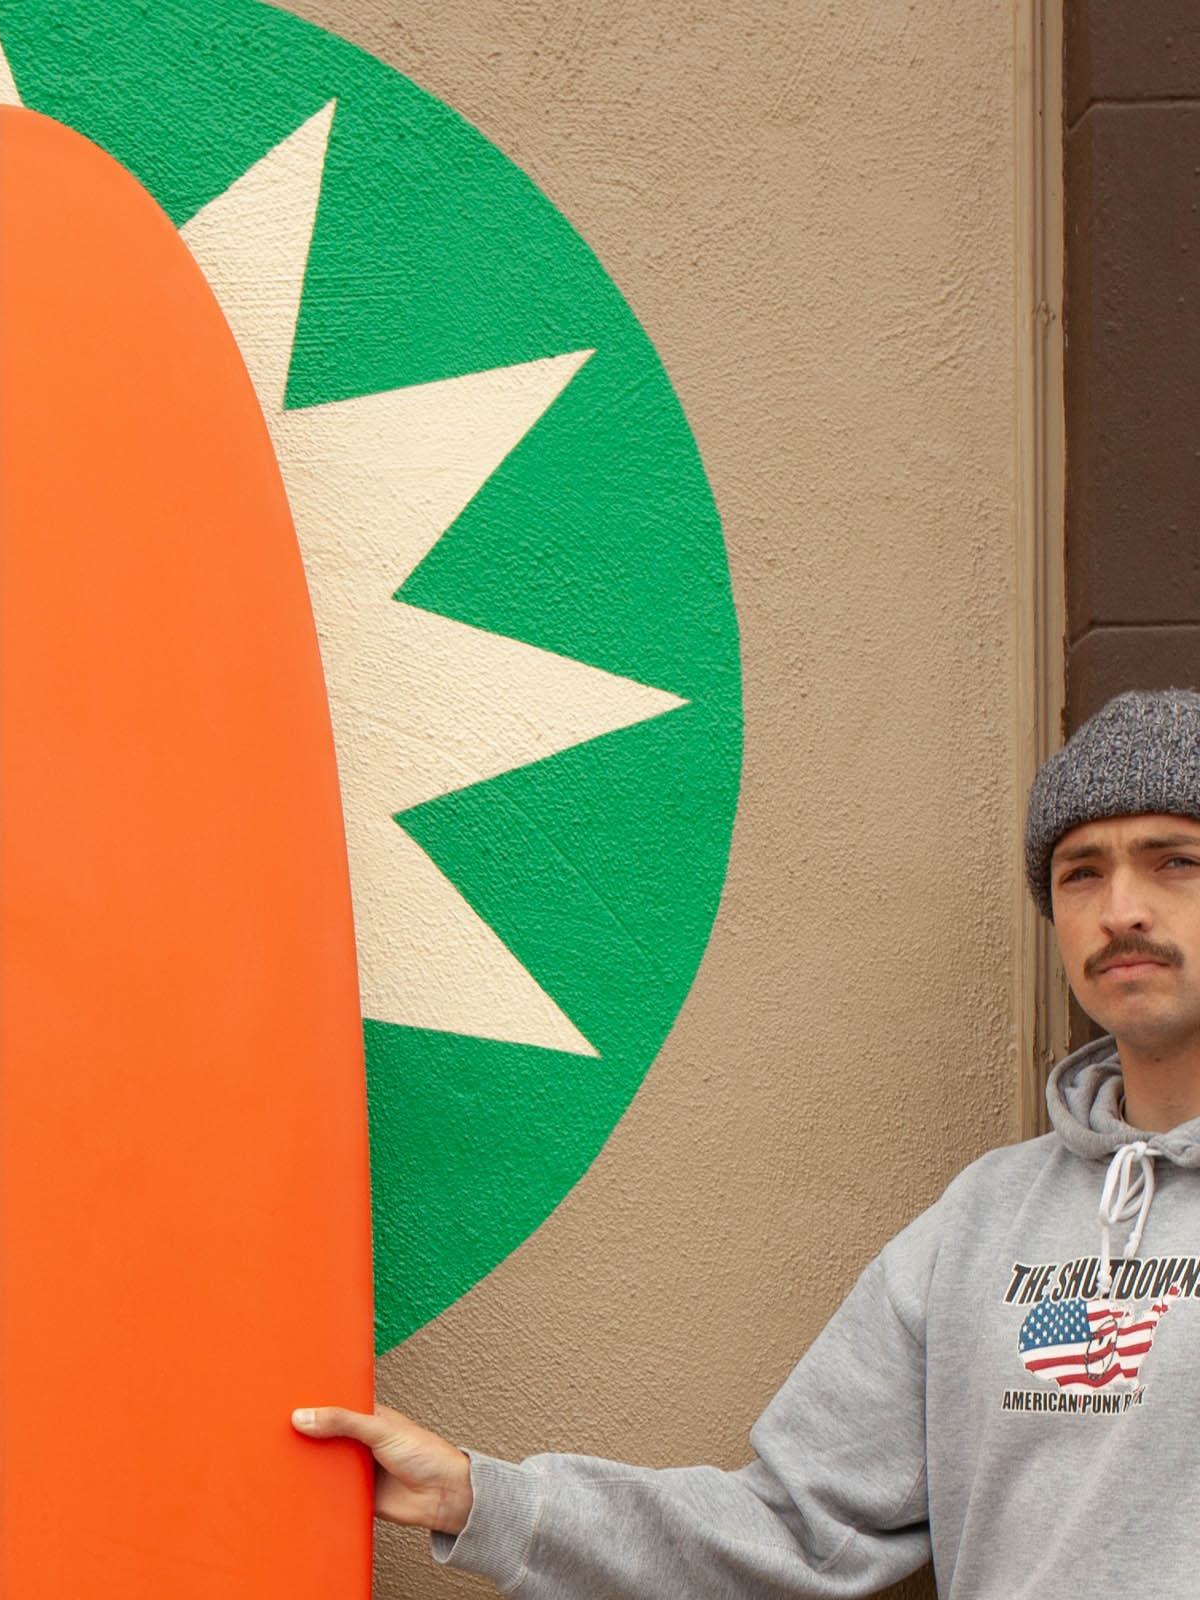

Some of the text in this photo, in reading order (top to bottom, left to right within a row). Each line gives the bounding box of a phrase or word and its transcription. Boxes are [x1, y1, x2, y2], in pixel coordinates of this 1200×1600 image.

[1004, 1257, 1200, 1303] THE SHUTDOWN
[1002, 1391, 1078, 1412] AMERICAN
[1081, 1393, 1121, 1414] PUNK
